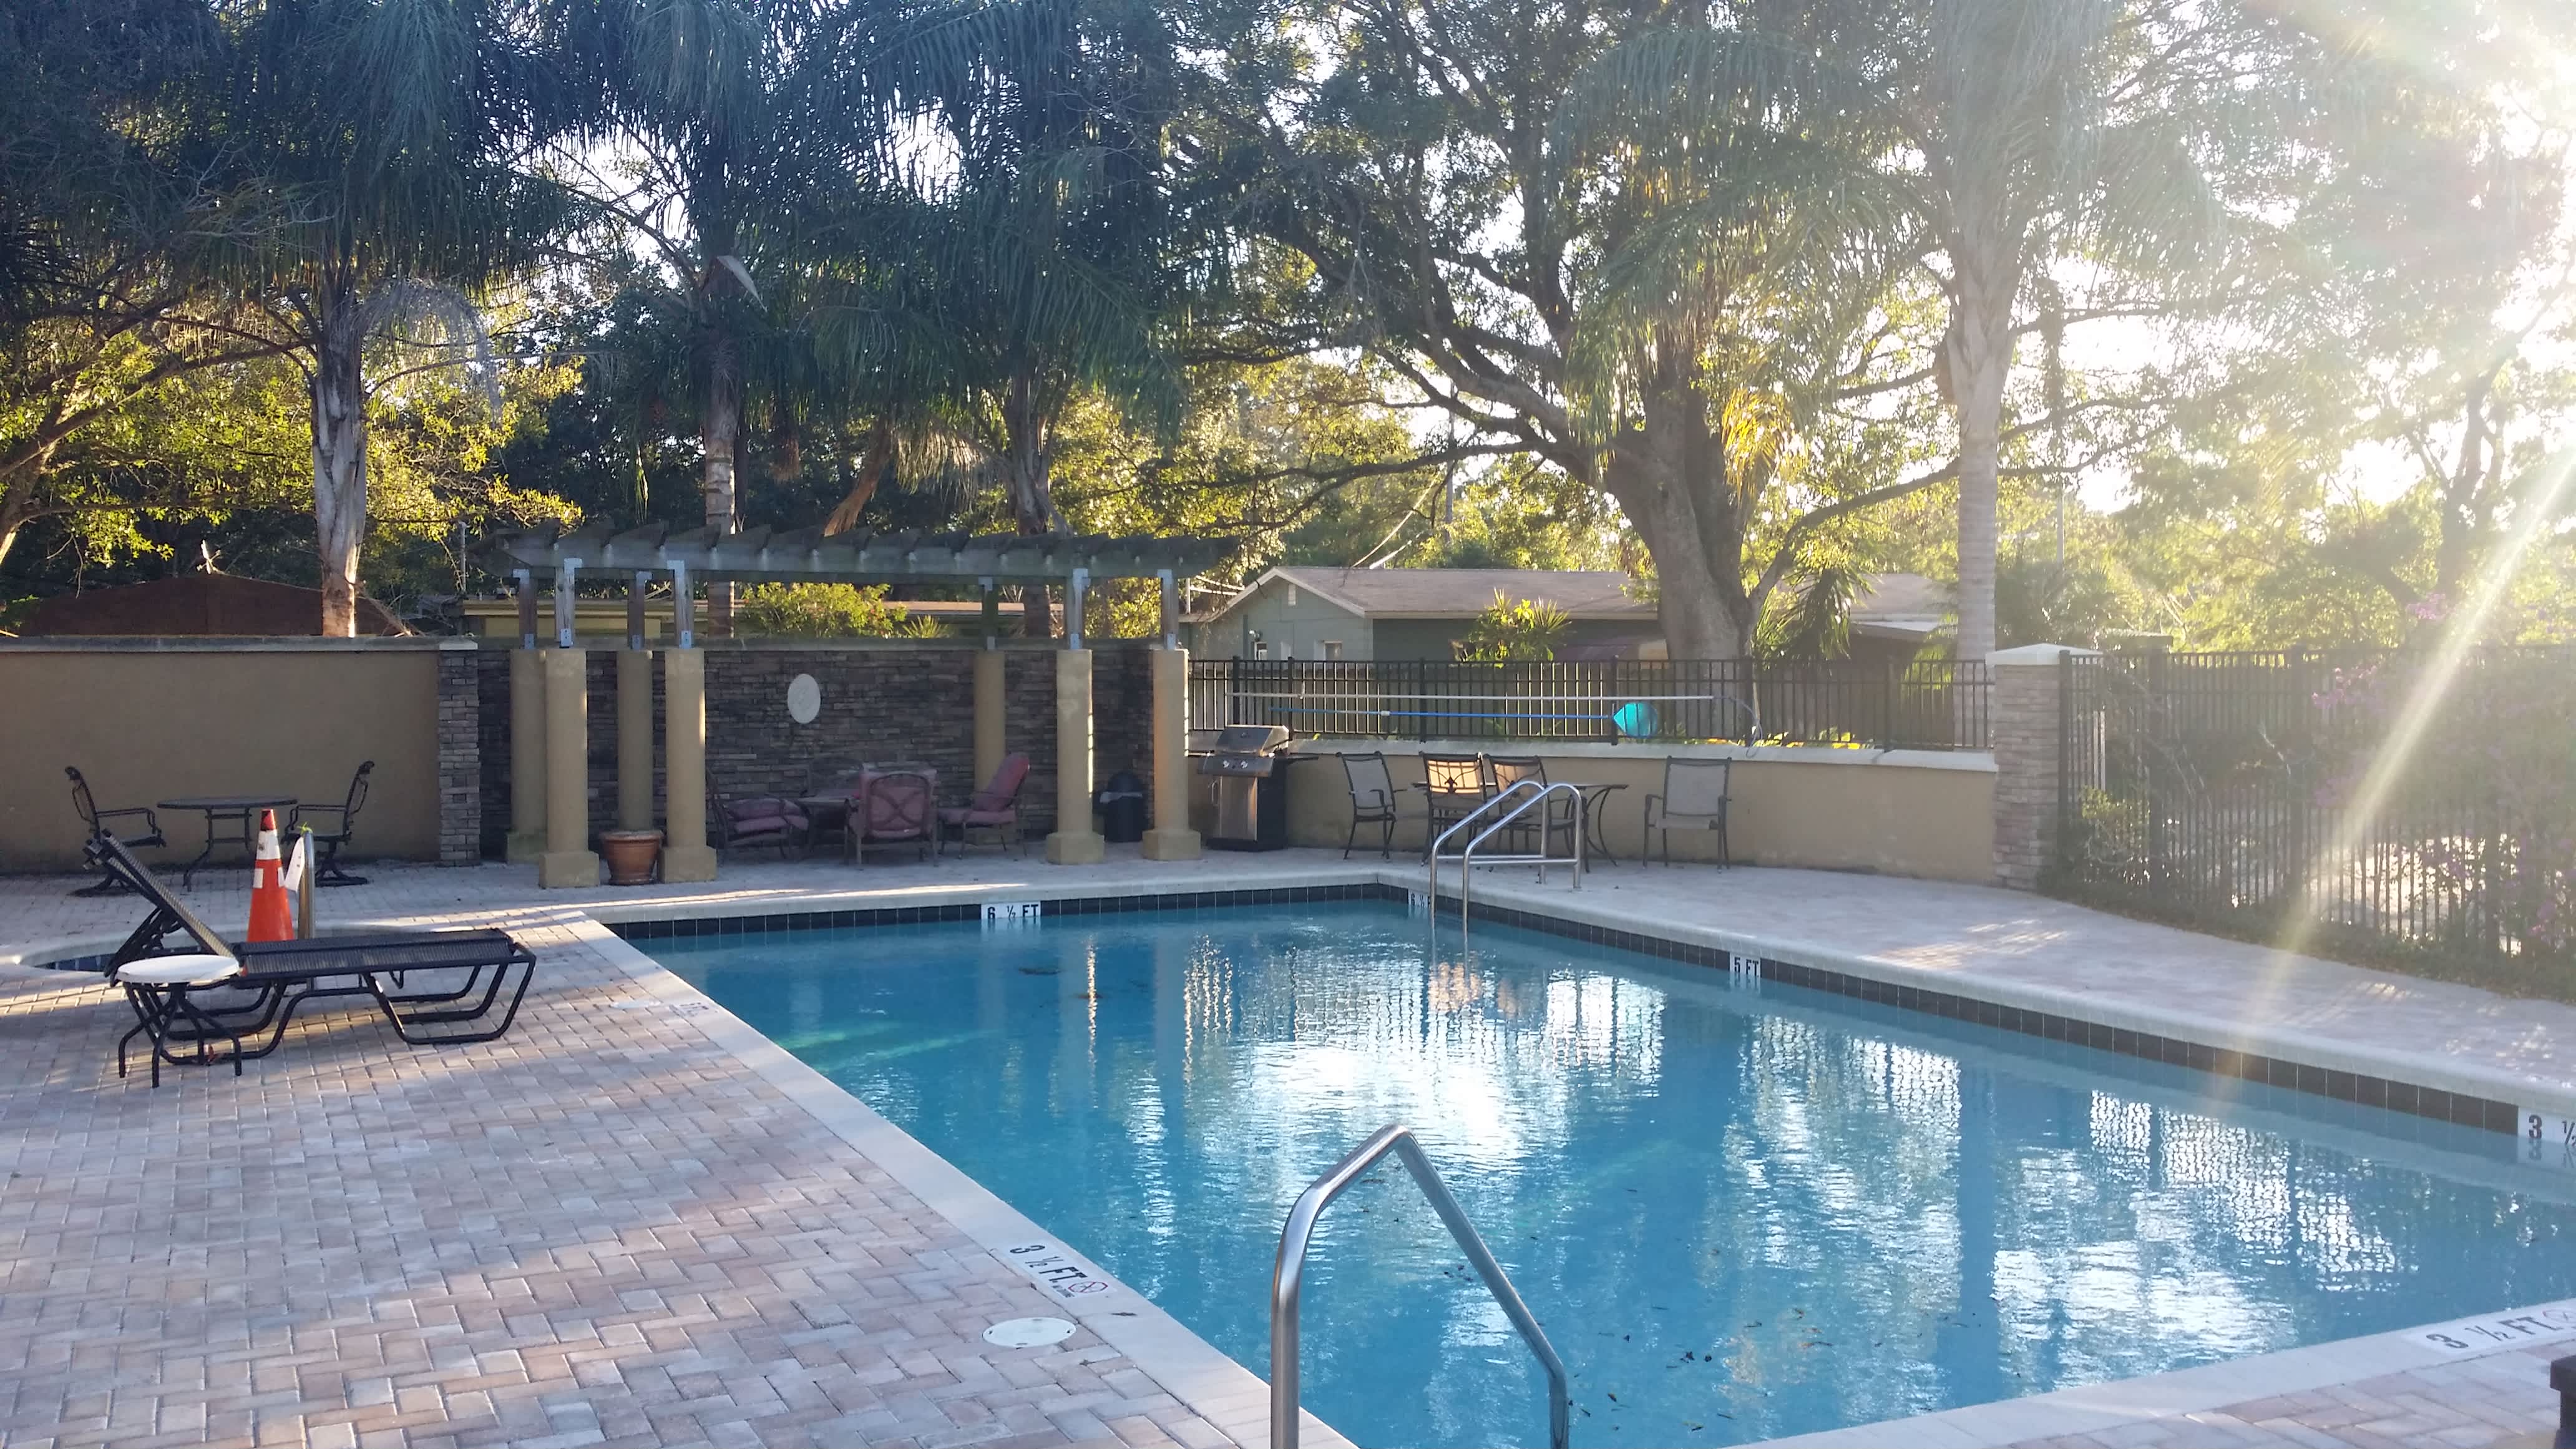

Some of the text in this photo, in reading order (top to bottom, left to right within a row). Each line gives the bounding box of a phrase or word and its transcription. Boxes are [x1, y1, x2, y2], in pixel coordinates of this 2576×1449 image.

[987, 907, 995, 919] 6
[1022, 904, 1038, 920] FT
[1734, 957, 1740, 973] 5
[2529, 1115, 2542, 1139] 3
[1010, 1245, 1046, 1254] 3
[2426, 1334, 2469, 1349] 3
